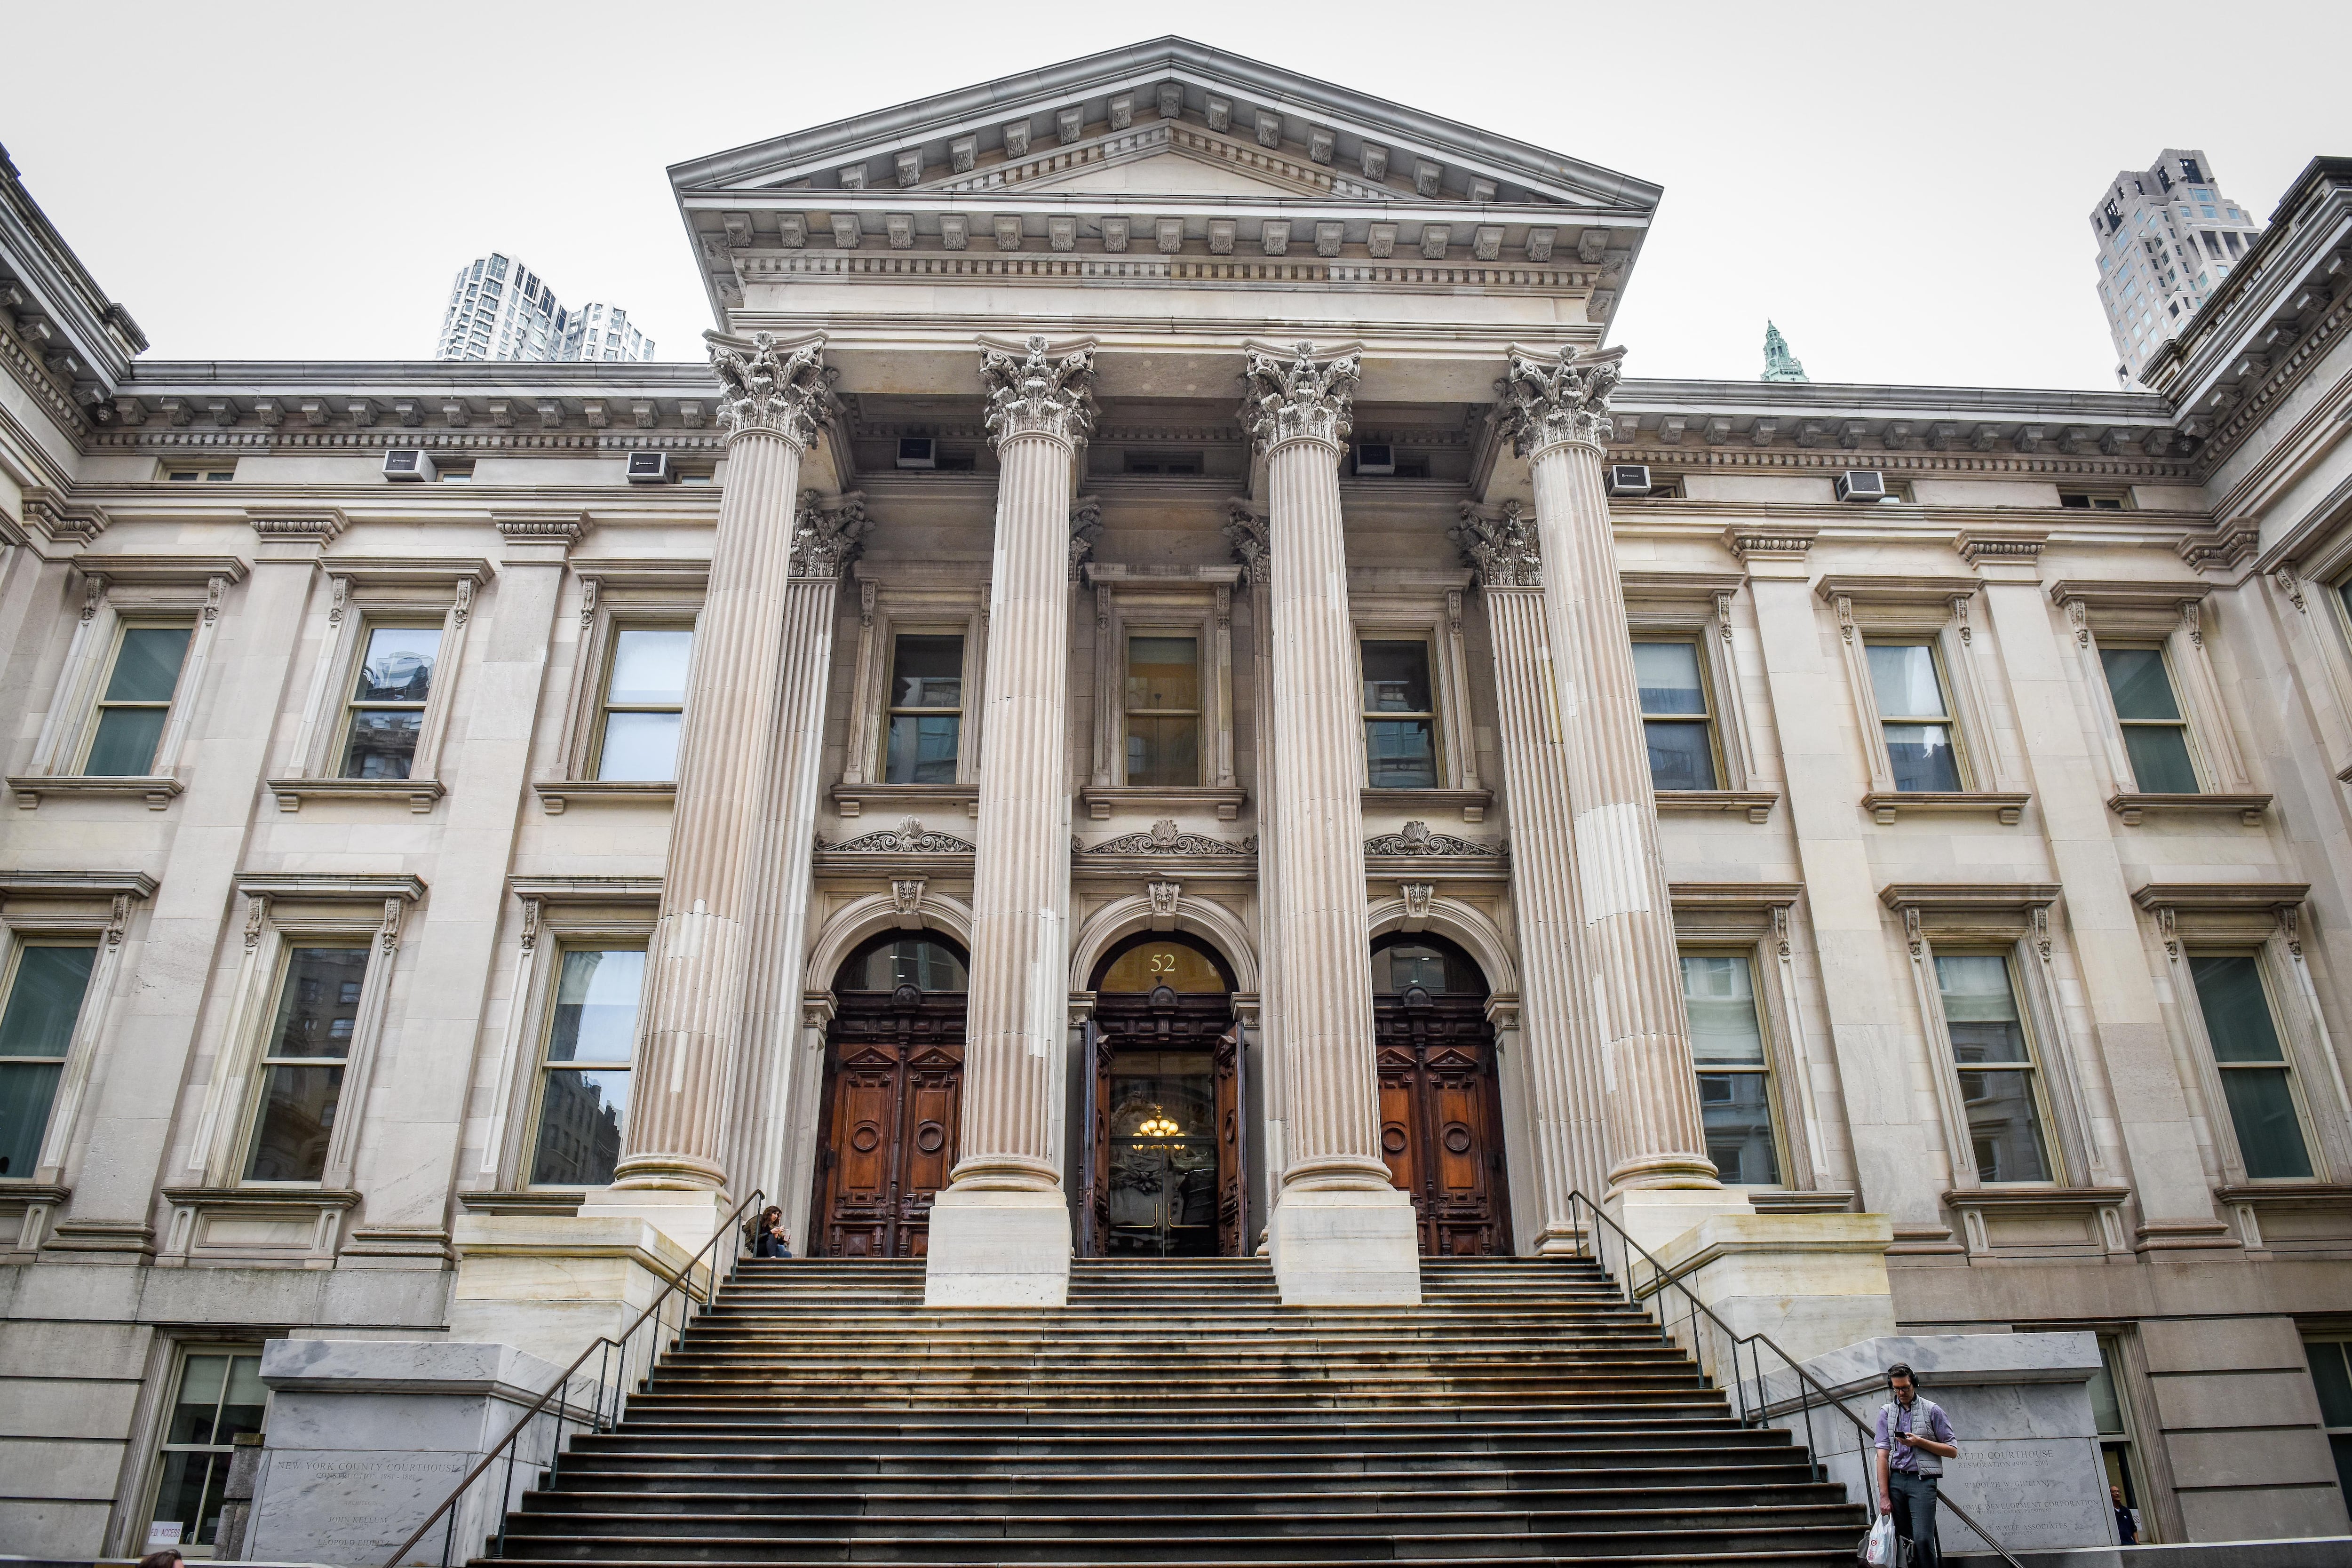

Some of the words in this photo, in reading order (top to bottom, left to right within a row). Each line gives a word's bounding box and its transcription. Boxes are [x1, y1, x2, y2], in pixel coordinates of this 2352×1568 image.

[1151, 954, 1176, 972] 52
[1987, 1450, 2054, 1460] COURTHOUSE
[339, 1463, 382, 1471] COUNTY
[387, 1464, 458, 1472] COURTHOUSE
[1986, 1502, 2042, 1510] DEVELOPMENT
[161, 1528, 181, 1537] ACCESS
